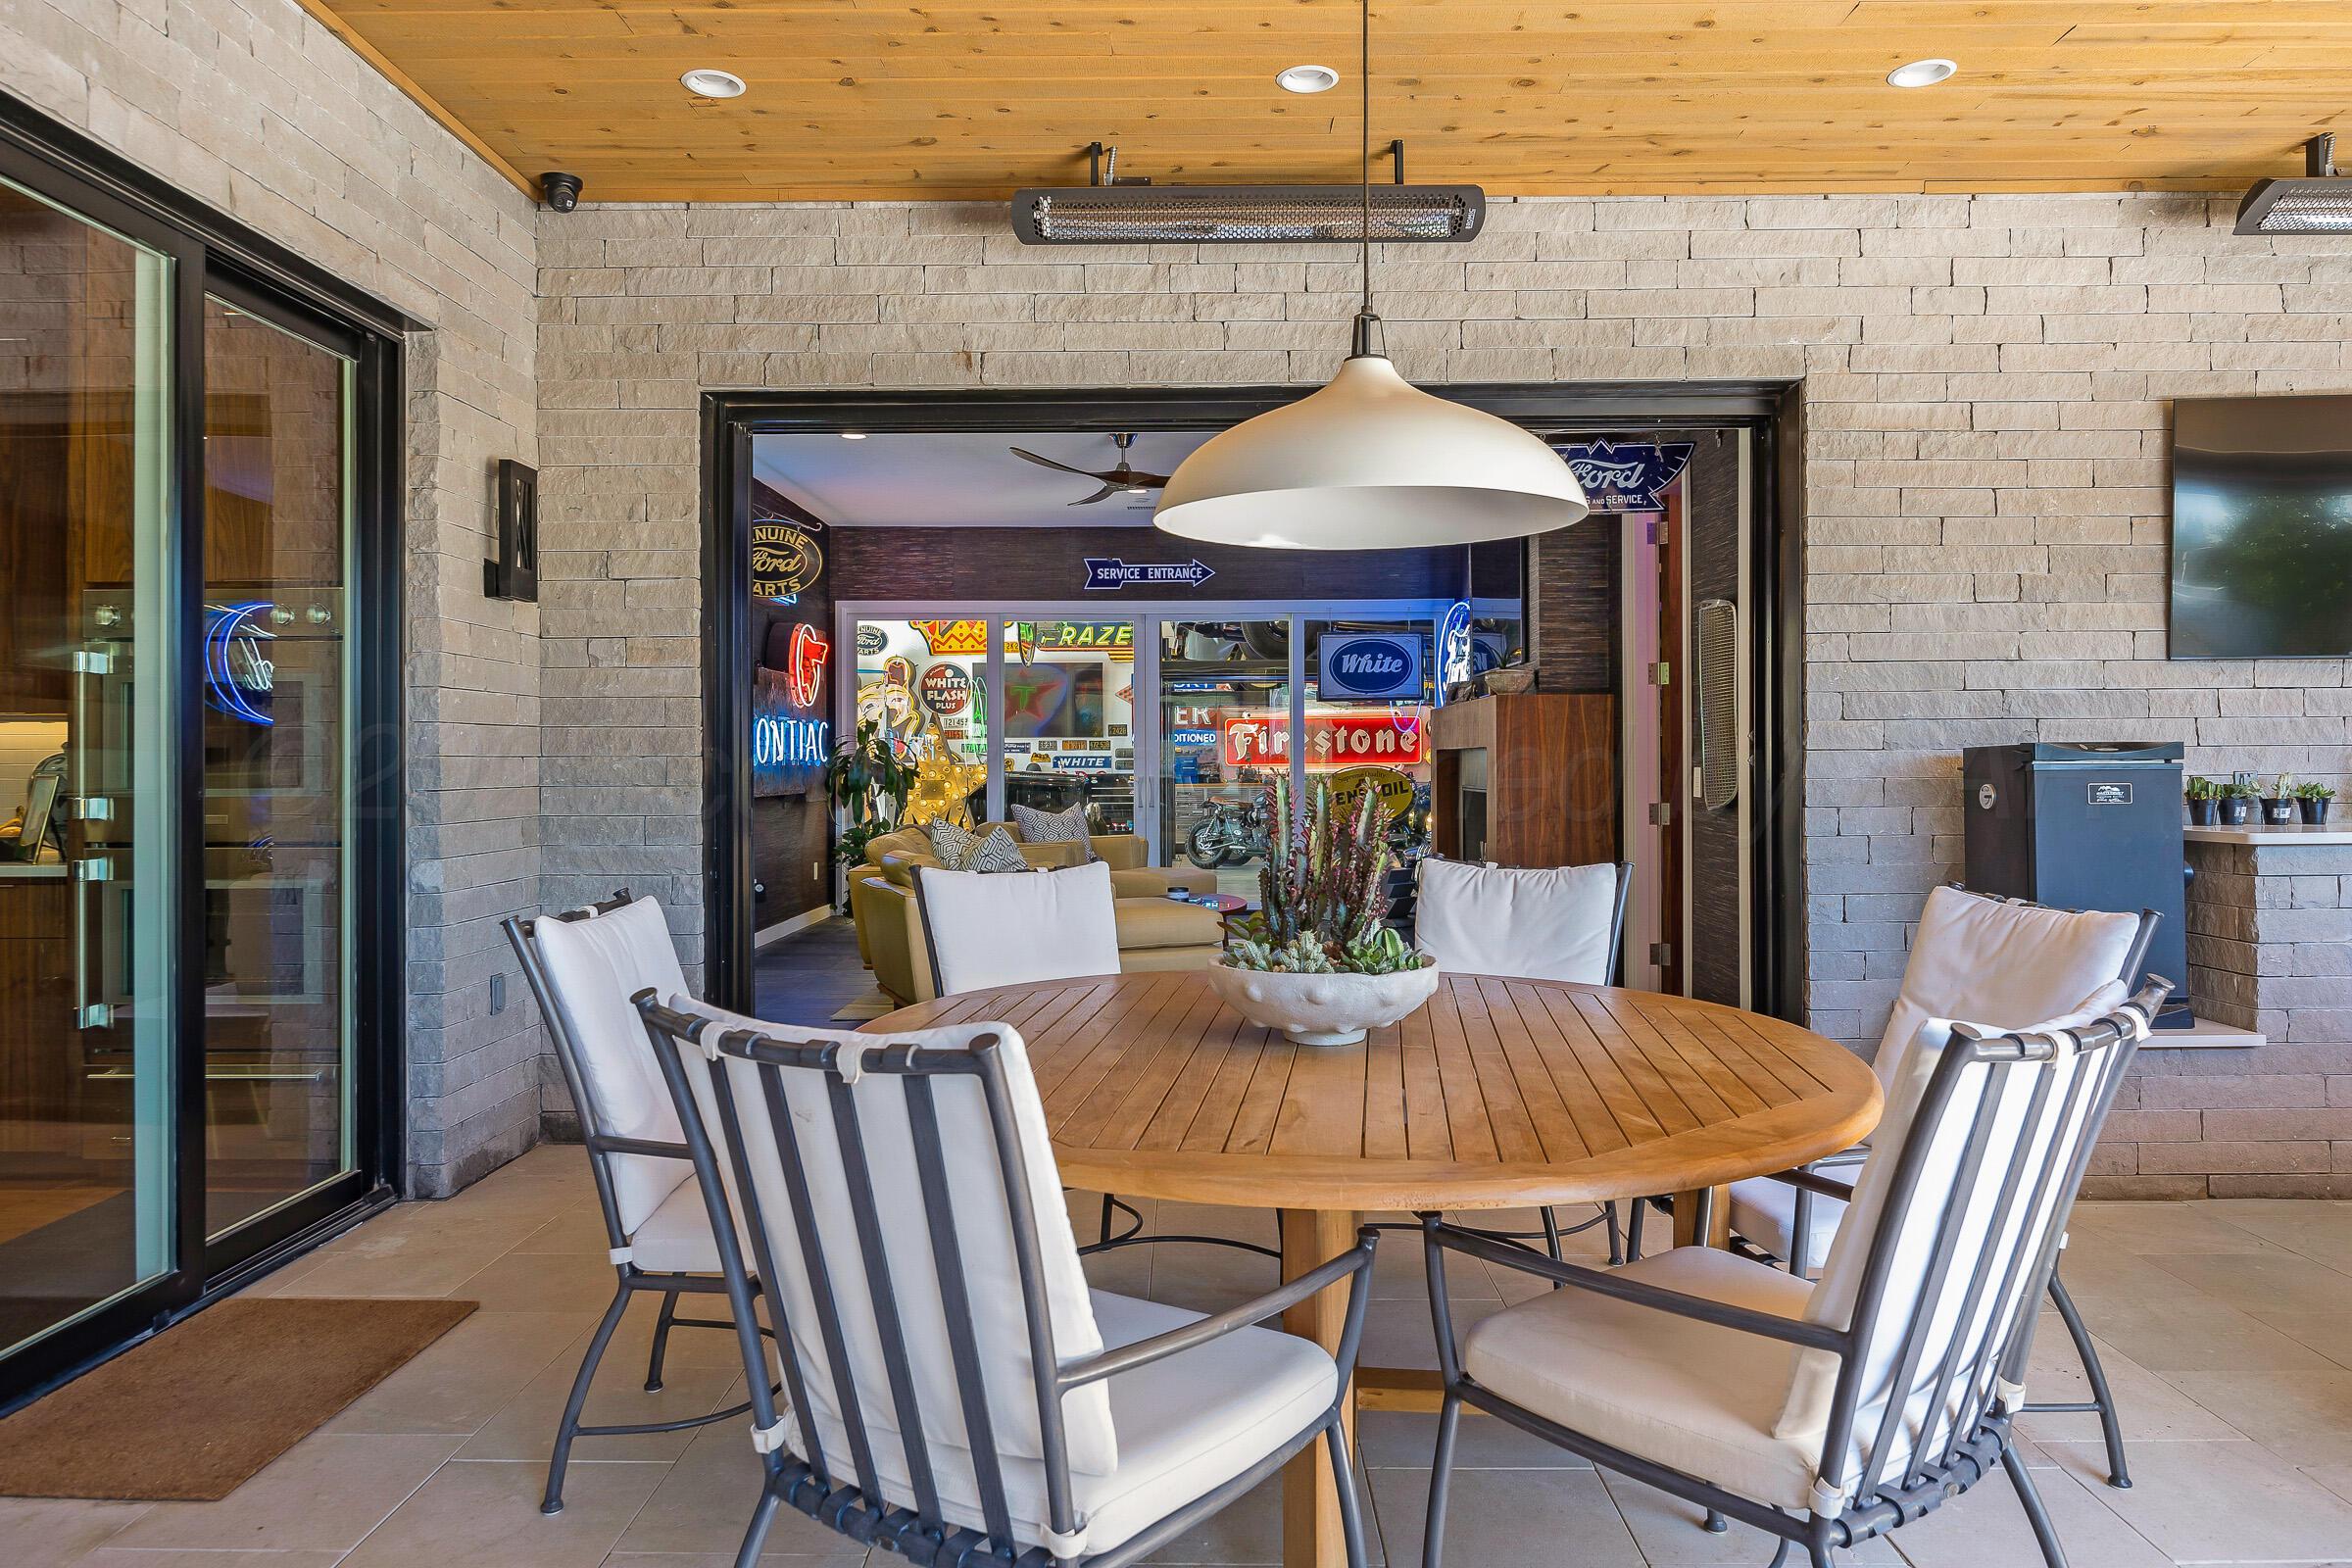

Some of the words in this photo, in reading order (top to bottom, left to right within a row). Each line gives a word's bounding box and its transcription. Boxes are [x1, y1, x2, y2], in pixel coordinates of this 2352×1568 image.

[1568, 459, 1645, 489] Ford
[1592, 496, 1605, 505] AND
[753, 527, 808, 550] NUINE
[1097, 567, 1141, 580] SERVICE
[1148, 566, 1203, 580] ENTRANCE
[1342, 653, 1402, 673] White
[925, 677, 967, 689] WHITE
[927, 689, 966, 701] FLASH
[756, 718, 829, 764] ONTIAC
[1229, 722, 1418, 762] Firstone
[1058, 758, 1105, 766] WHITE
